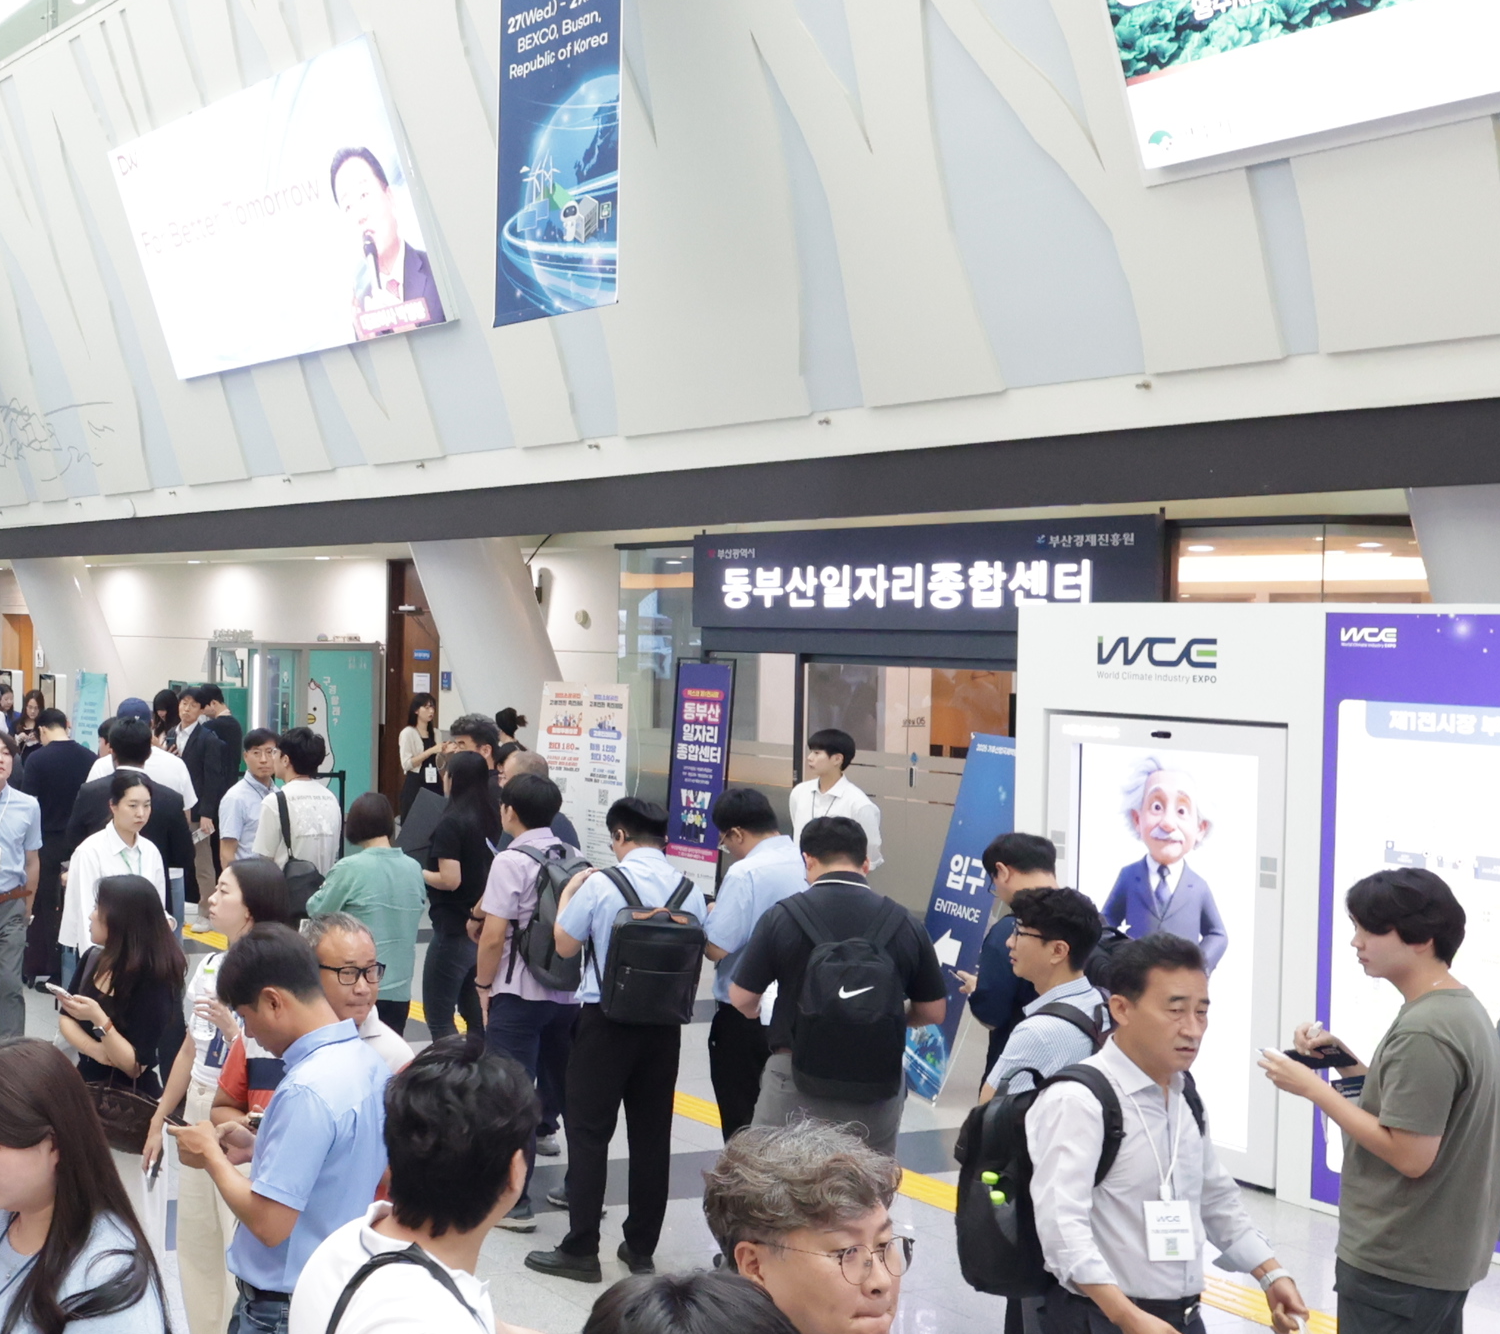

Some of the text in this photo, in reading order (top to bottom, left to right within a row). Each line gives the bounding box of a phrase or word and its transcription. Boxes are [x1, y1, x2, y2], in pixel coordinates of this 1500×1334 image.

[507, 0, 557, 34] 27(Wed.)
[516, 9, 603, 53] BEXCO, Busan,
[508, 31, 609, 80] Republic of Korea
[140, 178, 321, 257] For Better Tomorrow
[717, 547, 756, 560] 부산광역시
[1048, 532, 1136, 549] 부산경제진흥원
[721, 557, 1094, 610] 동부산일자리종합센터
[1339, 626, 1398, 643] WCE
[1096, 635, 1218, 669] WCE
[1096, 670, 1218, 685] World Climate Industry EXPO
[683, 702, 720, 722] 동부산
[1388, 708, 1476, 736] 제1전시장
[682, 724, 718, 744] 일자리
[676, 743, 721, 764] 종합센터
[945, 853, 987, 896] 입구
[933, 896, 982, 924] ENTRANCE
